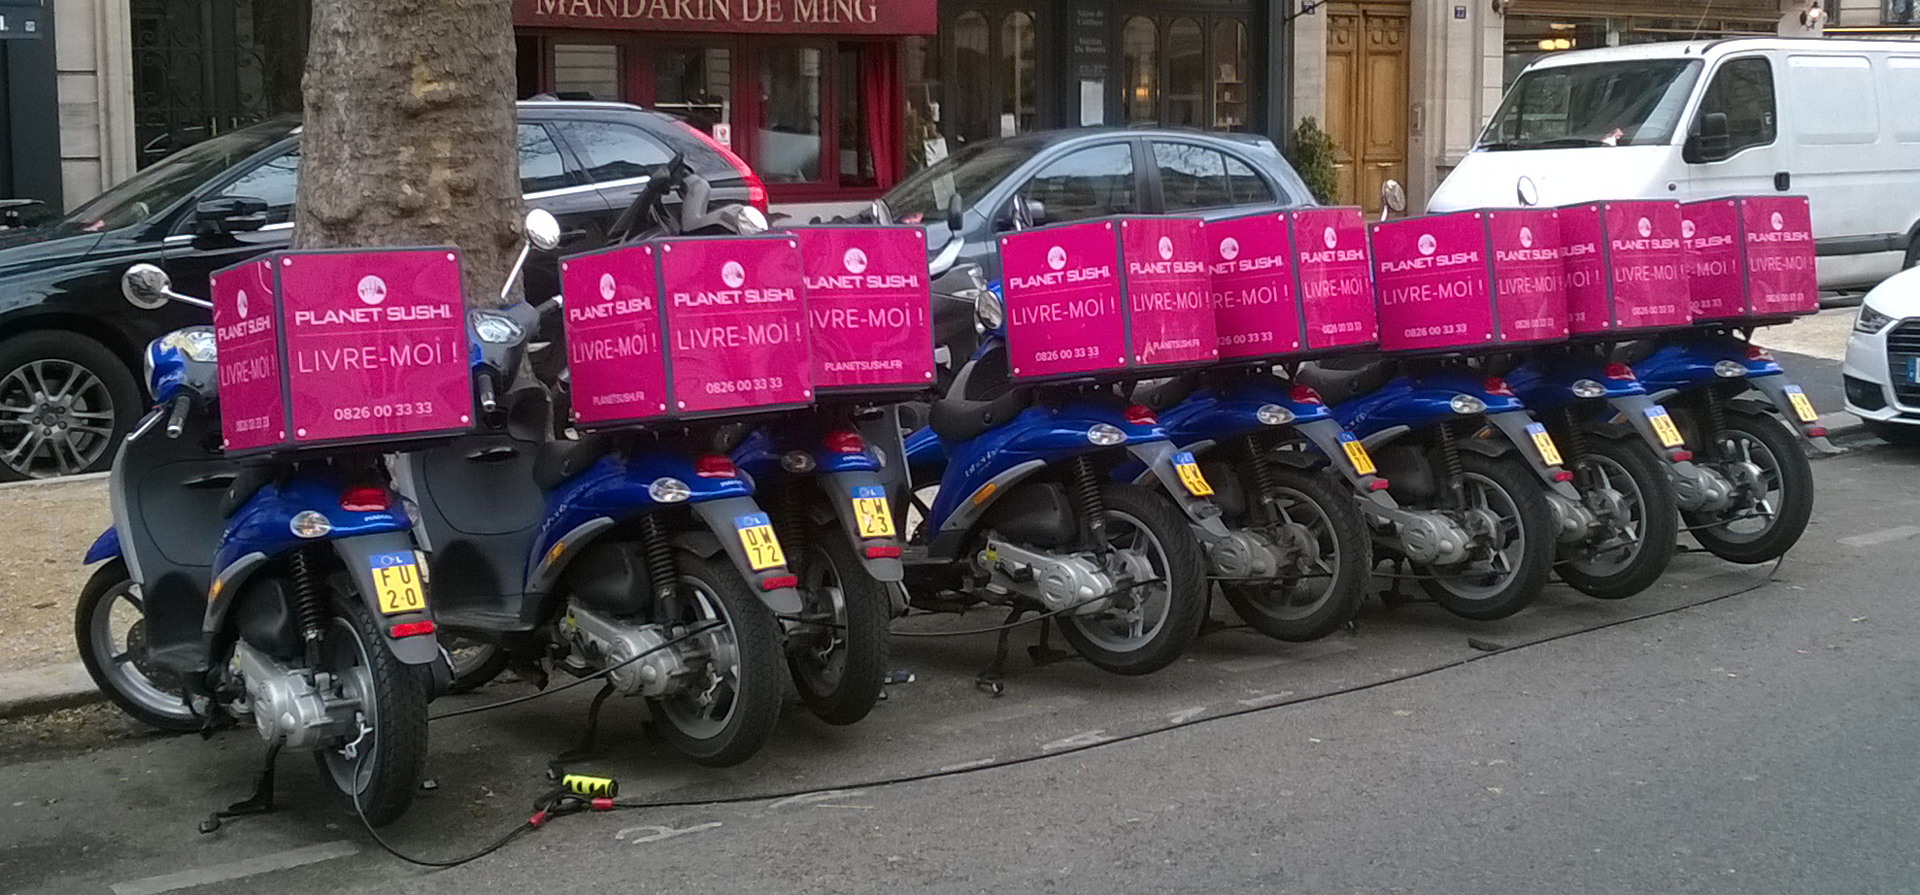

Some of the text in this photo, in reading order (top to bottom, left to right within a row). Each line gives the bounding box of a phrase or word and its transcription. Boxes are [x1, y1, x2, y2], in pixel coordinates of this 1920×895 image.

[535, 0, 877, 24] MANDARIN DE MING
[1612, 240, 1650, 251] PLANET
[1747, 232, 1781, 242] PLANET
[1301, 251, 1336, 264] PLANET
[1381, 256, 1435, 273] PLANET
[1496, 250, 1531, 262] PLANET
[1130, 262, 1172, 275] PLANET
[1208, 261, 1237, 275] NET
[803, 276, 864, 289] LANET
[1010, 272, 1064, 290] PLANET
[674, 290, 743, 307] PLANET
[1284, 284, 1289, 301] !
[570, 302, 614, 322] PLANET
[1111, 296, 1115, 314] !
[295, 307, 383, 326] PLANET
[918, 307, 924, 326] !
[218, 323, 248, 342] PLANET
[795, 322, 801, 343] !
[1233, 334, 1246, 344] 00
[1248, 332, 1259, 342] 33
[1261, 331, 1273, 341] 33
[1404, 323, 1467, 338] 0826 00 33 33
[652, 333, 657, 353] !
[452, 342, 458, 363] !
[1035, 346, 1099, 362] 0826 00 33 33
[706, 377, 782, 394] 0826 00 33 33
[333, 402, 433, 420] 0826 00 33 33
[859, 498, 884, 515] CW
[866, 516, 889, 534] 23
[745, 528, 773, 547] DW
[396, 555, 403, 564] L
[752, 546, 779, 565] 72
[380, 565, 411, 587] FU
[387, 588, 417, 609] 20
